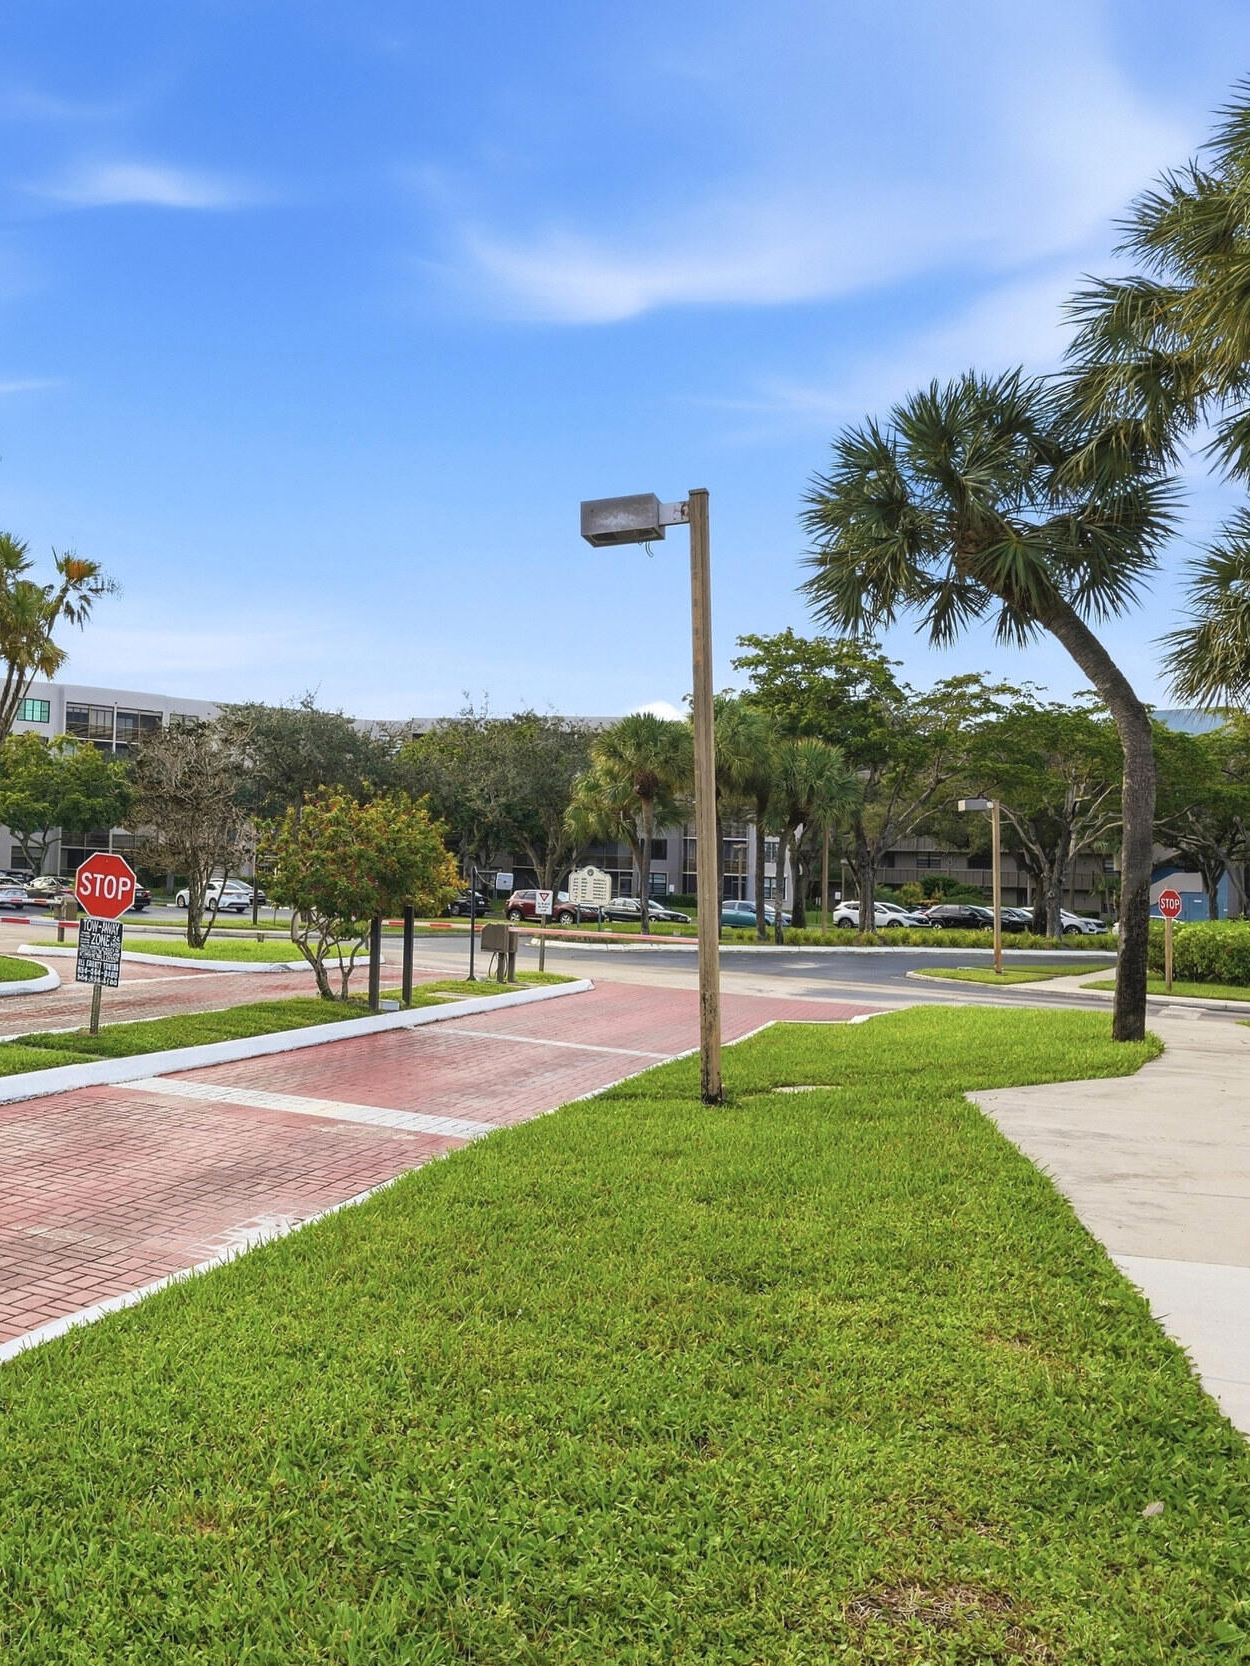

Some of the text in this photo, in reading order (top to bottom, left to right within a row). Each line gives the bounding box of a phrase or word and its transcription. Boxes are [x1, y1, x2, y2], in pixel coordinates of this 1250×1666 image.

[79, 871, 131, 901] STOP
[1160, 898, 1180, 910] STOP
[90, 933, 111, 947] ZONE
